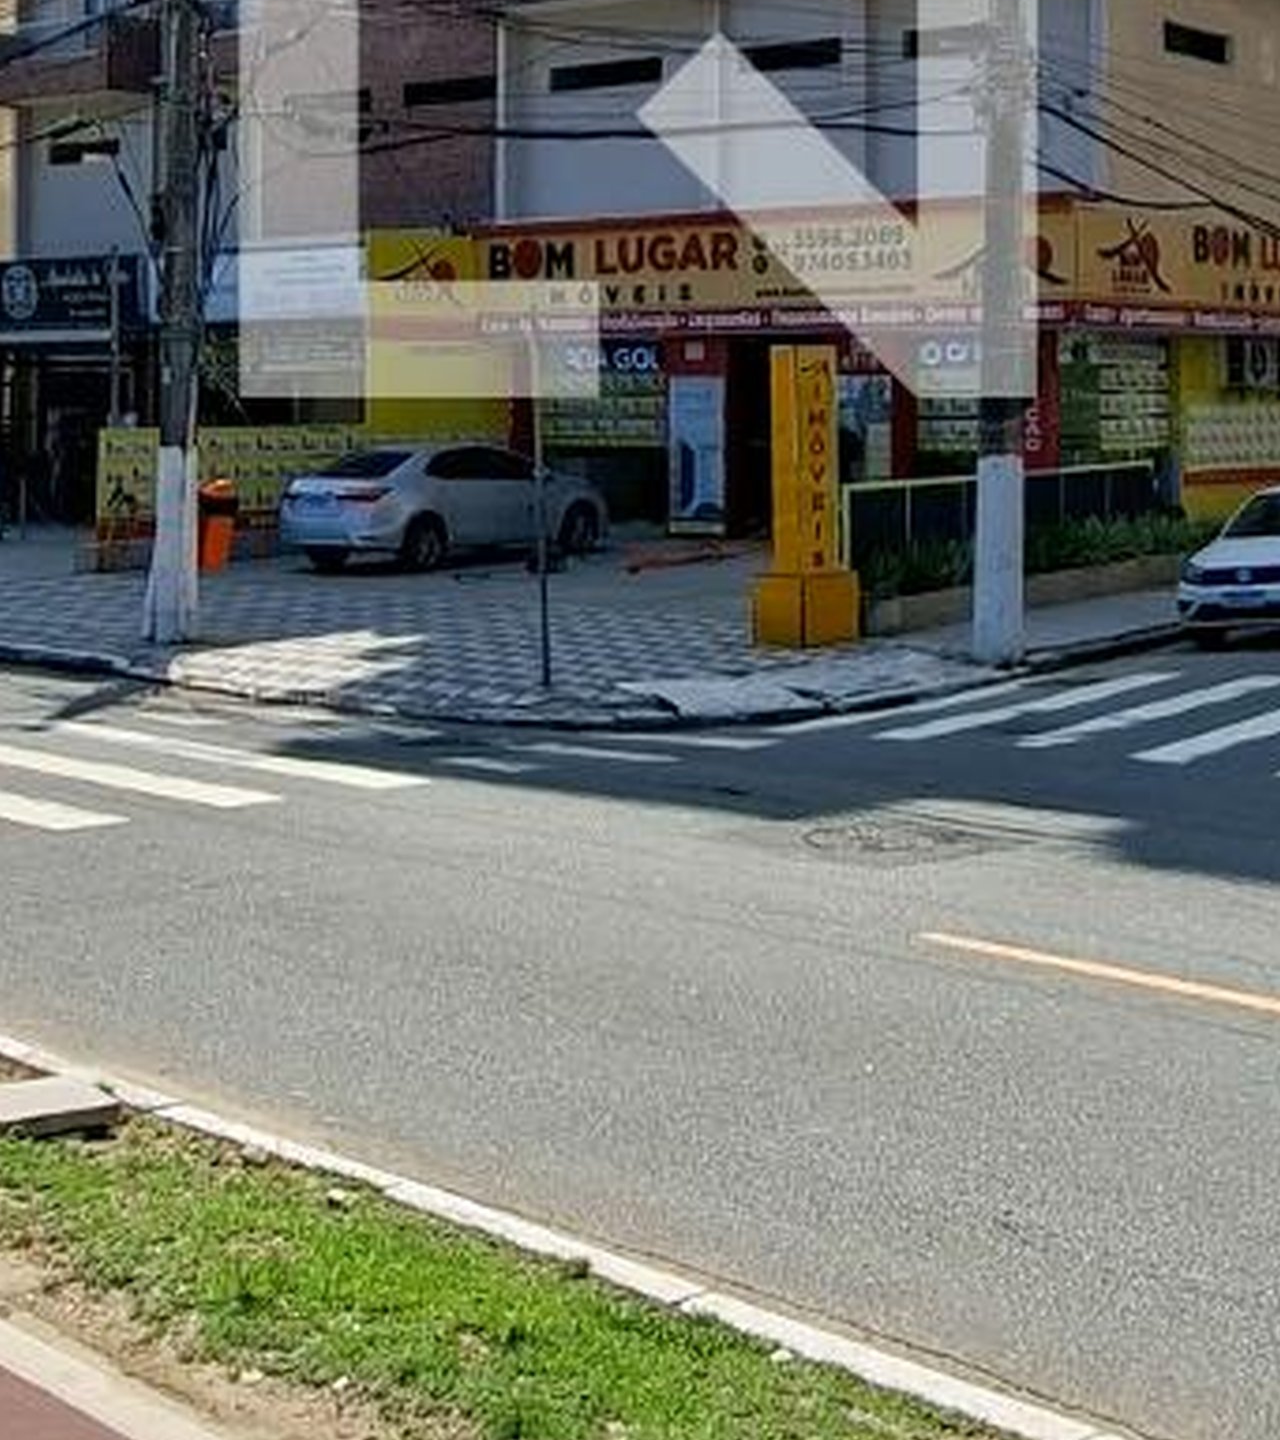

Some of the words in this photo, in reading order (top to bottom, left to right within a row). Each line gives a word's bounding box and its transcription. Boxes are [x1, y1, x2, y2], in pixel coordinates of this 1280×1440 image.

[489, 238, 574, 280] BOM
[594, 231, 739, 275] LUGAR
[1192, 224, 1250, 270] BOM
[540, 281, 694, 304] MÓVEIS
